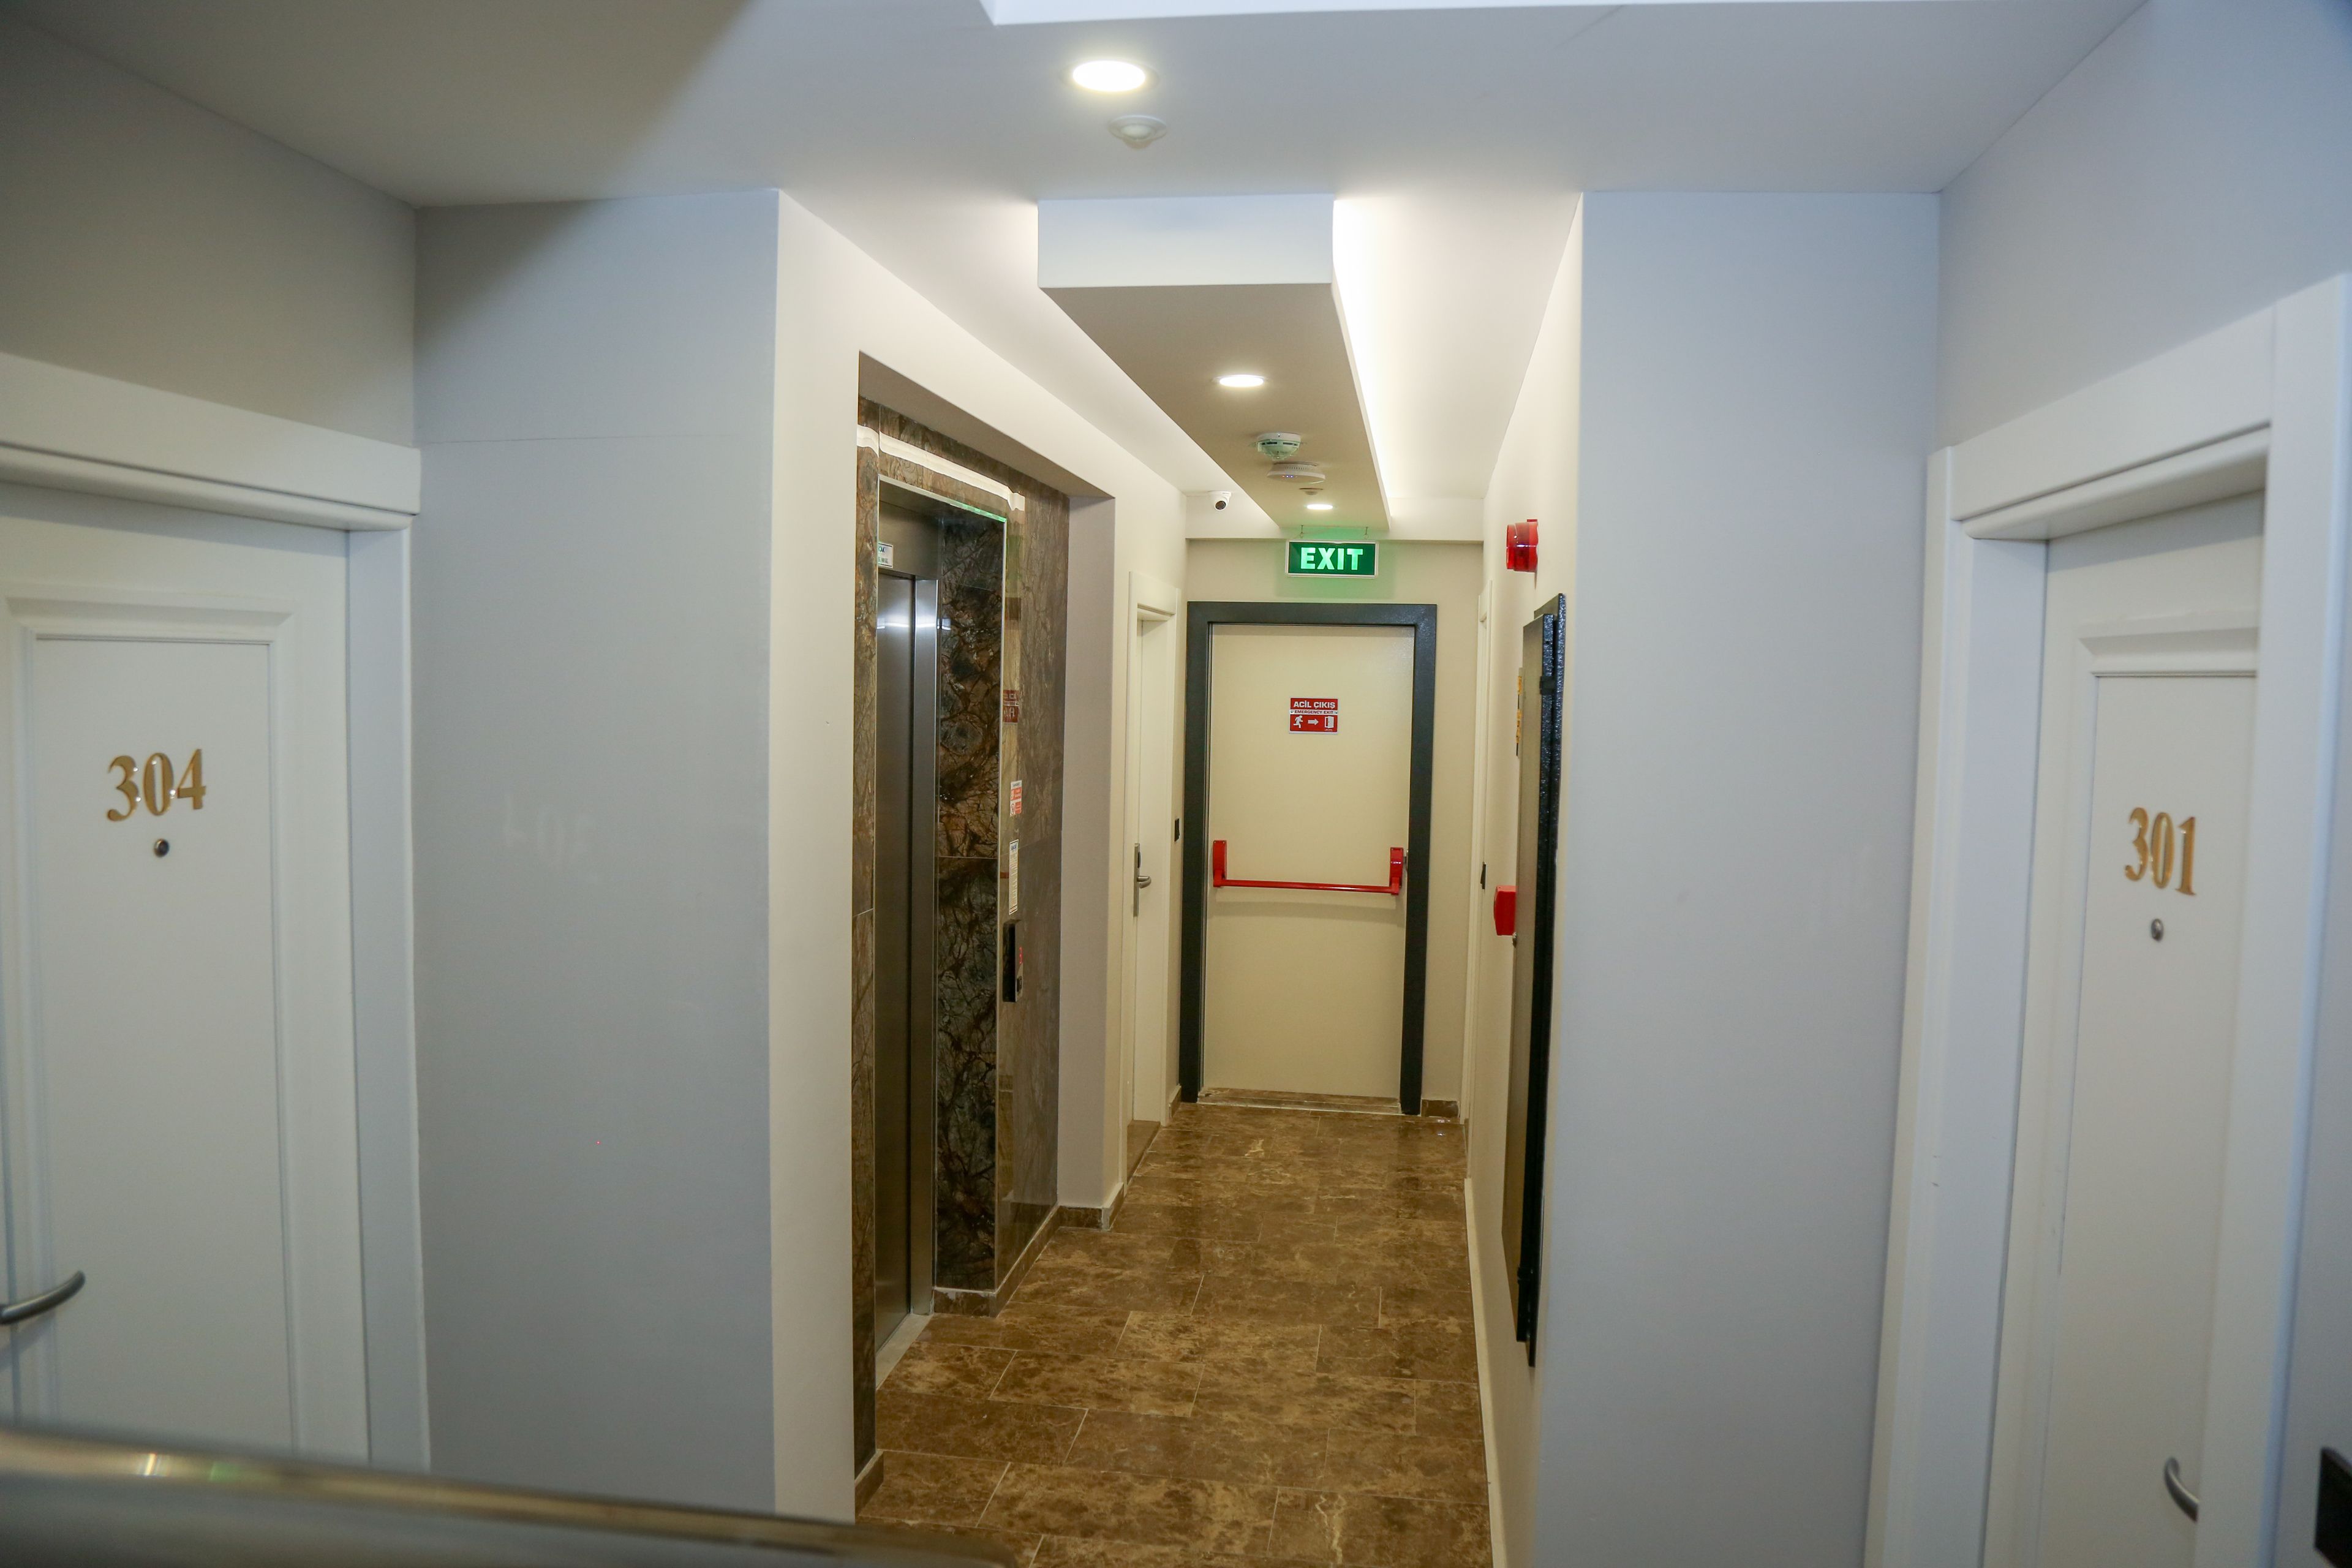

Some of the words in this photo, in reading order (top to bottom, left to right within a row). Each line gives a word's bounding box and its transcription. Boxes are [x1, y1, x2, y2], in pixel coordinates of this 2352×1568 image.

[1300, 547, 1363, 570] EXIT
[107, 748, 206, 822] 304
[2125, 807, 2196, 895] 301
